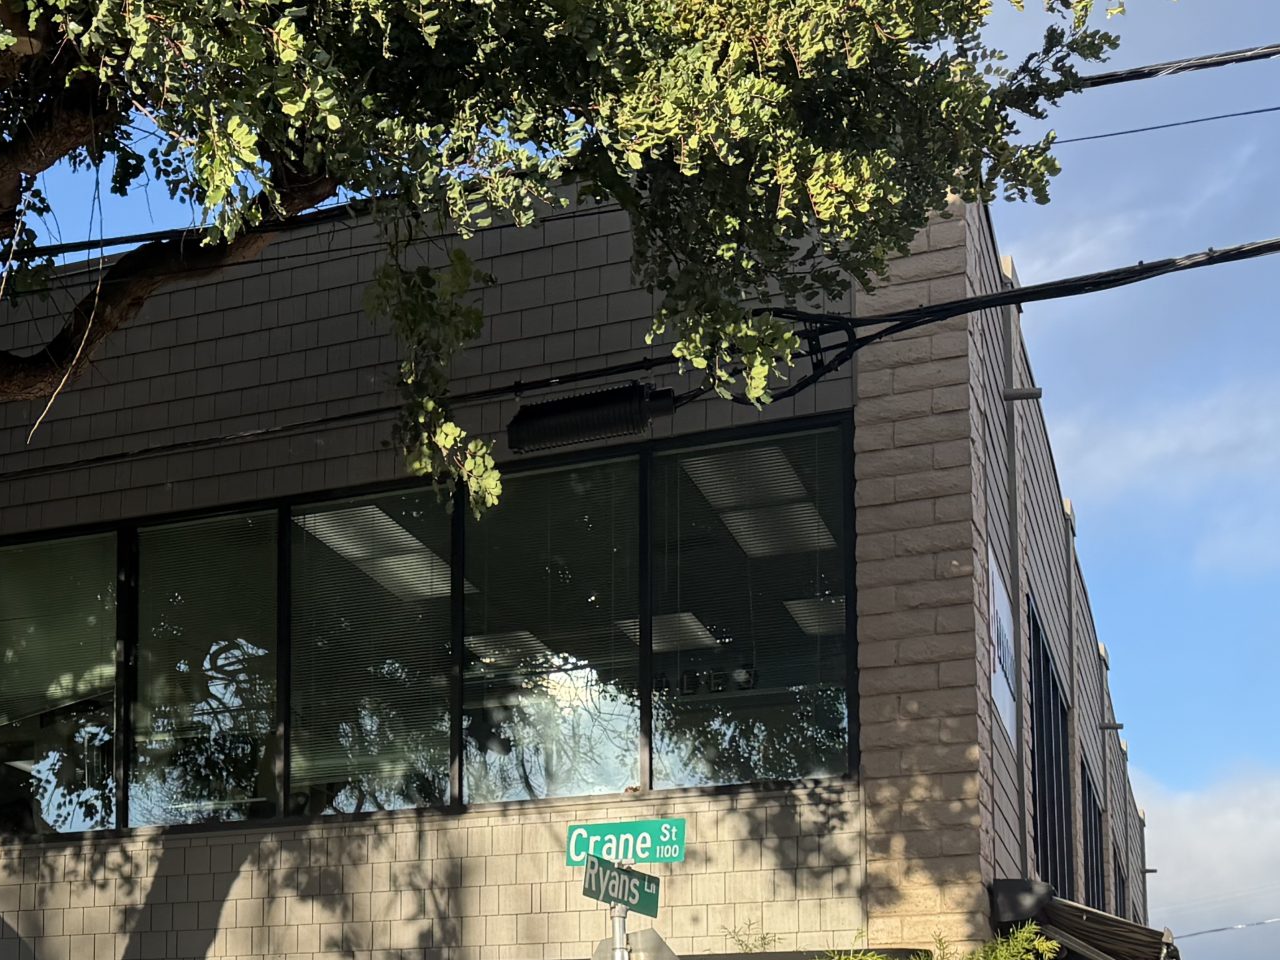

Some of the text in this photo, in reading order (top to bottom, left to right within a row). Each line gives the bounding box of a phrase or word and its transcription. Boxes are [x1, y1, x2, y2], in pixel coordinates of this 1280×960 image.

[569, 823, 678, 862] Crane St
[656, 844, 679, 858] 1100
[585, 855, 656, 905] Ryans Ln
